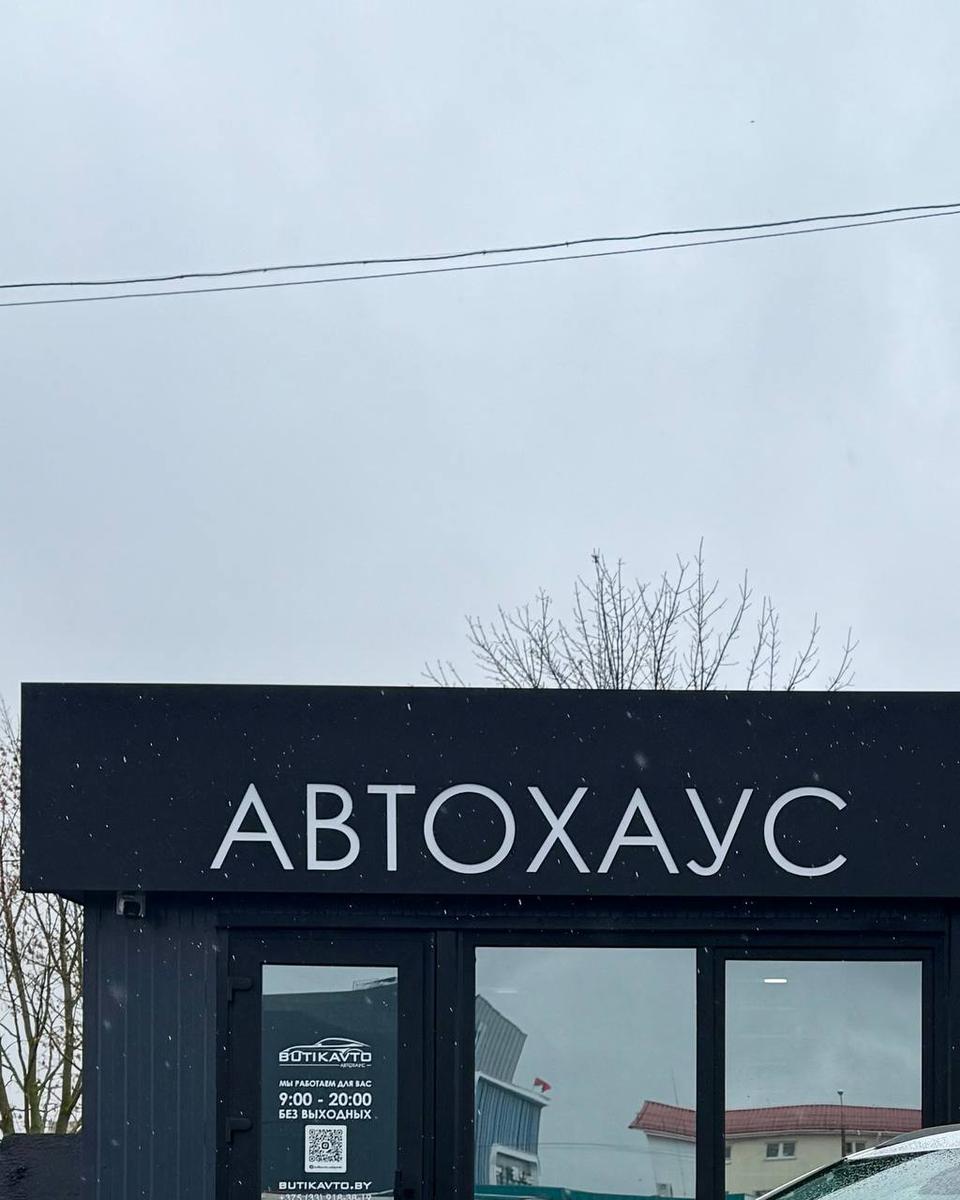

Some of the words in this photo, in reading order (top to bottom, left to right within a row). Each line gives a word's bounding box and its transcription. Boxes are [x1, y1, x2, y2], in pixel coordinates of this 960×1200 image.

[210, 783, 848, 877] АВТОХАУС
[279, 1052, 372, 1063] BUTIKAVTO
[337, 1080, 354, 1088] ДЛЯ
[279, 1092, 313, 1106] 9:00
[328, 1092, 372, 1106] 20:00
[279, 1109, 298, 1119] БЕЗ
[301, 1109, 371, 1120] ВЫХОДНЫХ
[279, 1181, 372, 1190] BUTIKAVTO.BY
